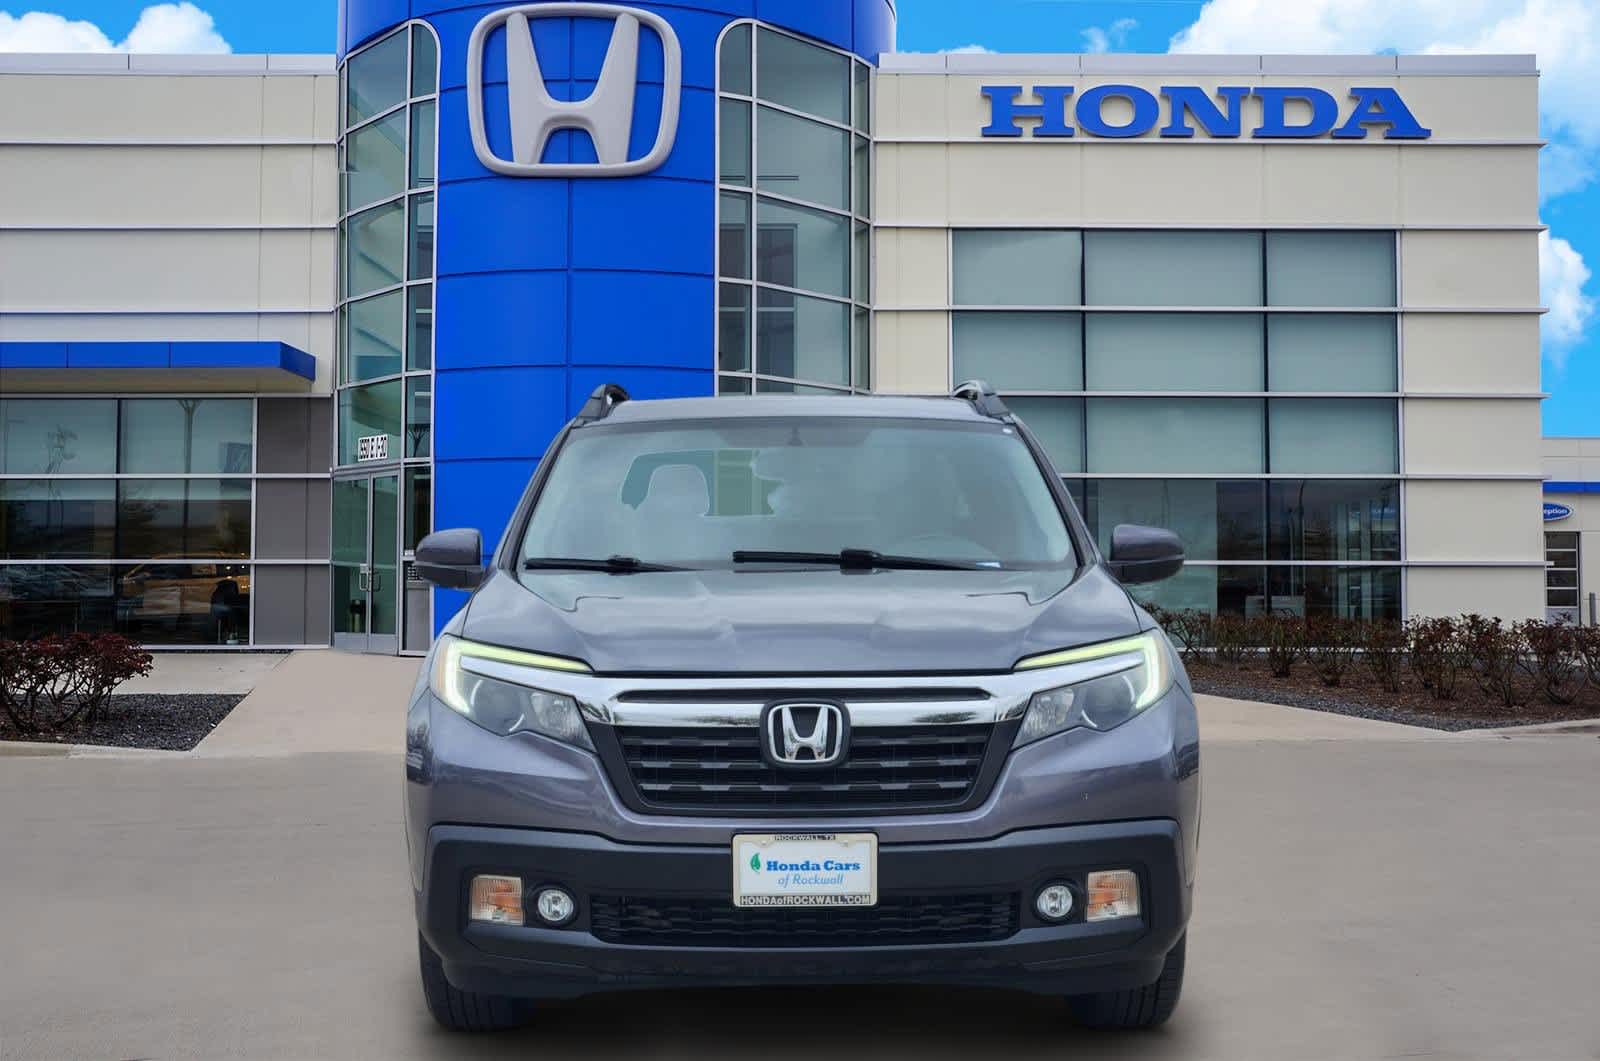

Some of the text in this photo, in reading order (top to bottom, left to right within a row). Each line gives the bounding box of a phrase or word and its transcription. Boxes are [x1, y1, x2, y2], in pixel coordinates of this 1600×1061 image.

[981, 84, 1432, 139] HONDA
[766, 860, 861, 872] Honda Cars
[777, 873, 844, 888] of Rockwall
